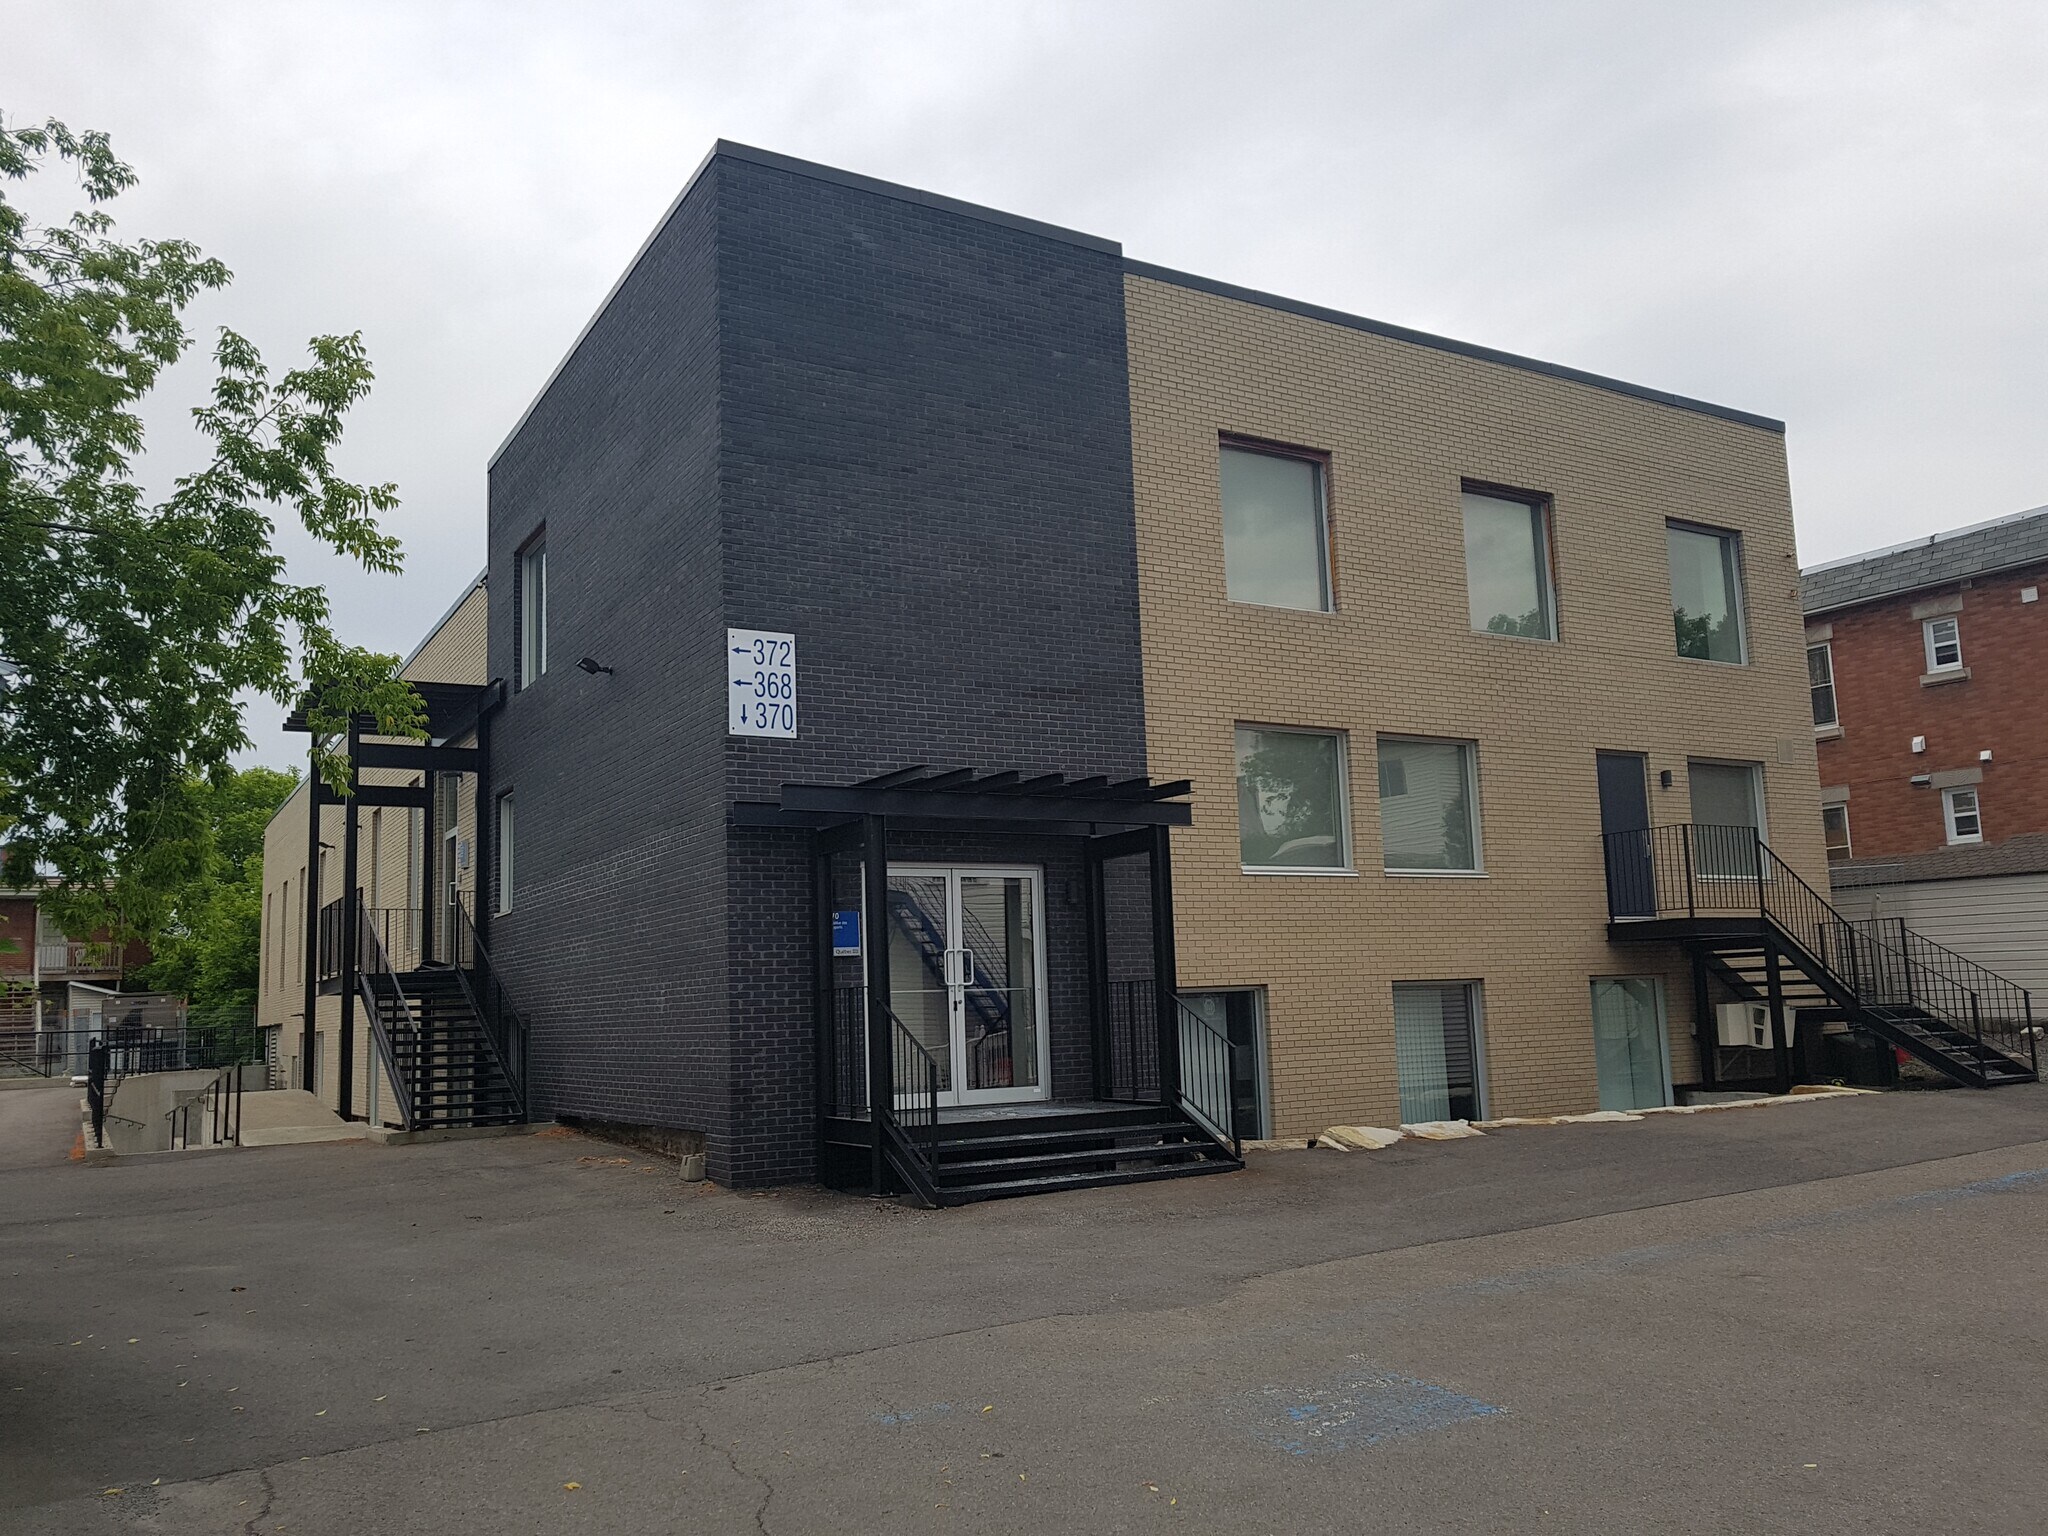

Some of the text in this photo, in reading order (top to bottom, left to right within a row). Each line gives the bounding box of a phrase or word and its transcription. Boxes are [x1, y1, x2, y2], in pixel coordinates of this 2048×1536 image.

[753, 639, 791, 667] 372
[754, 671, 792, 699] 368
[755, 702, 793, 730] 370
